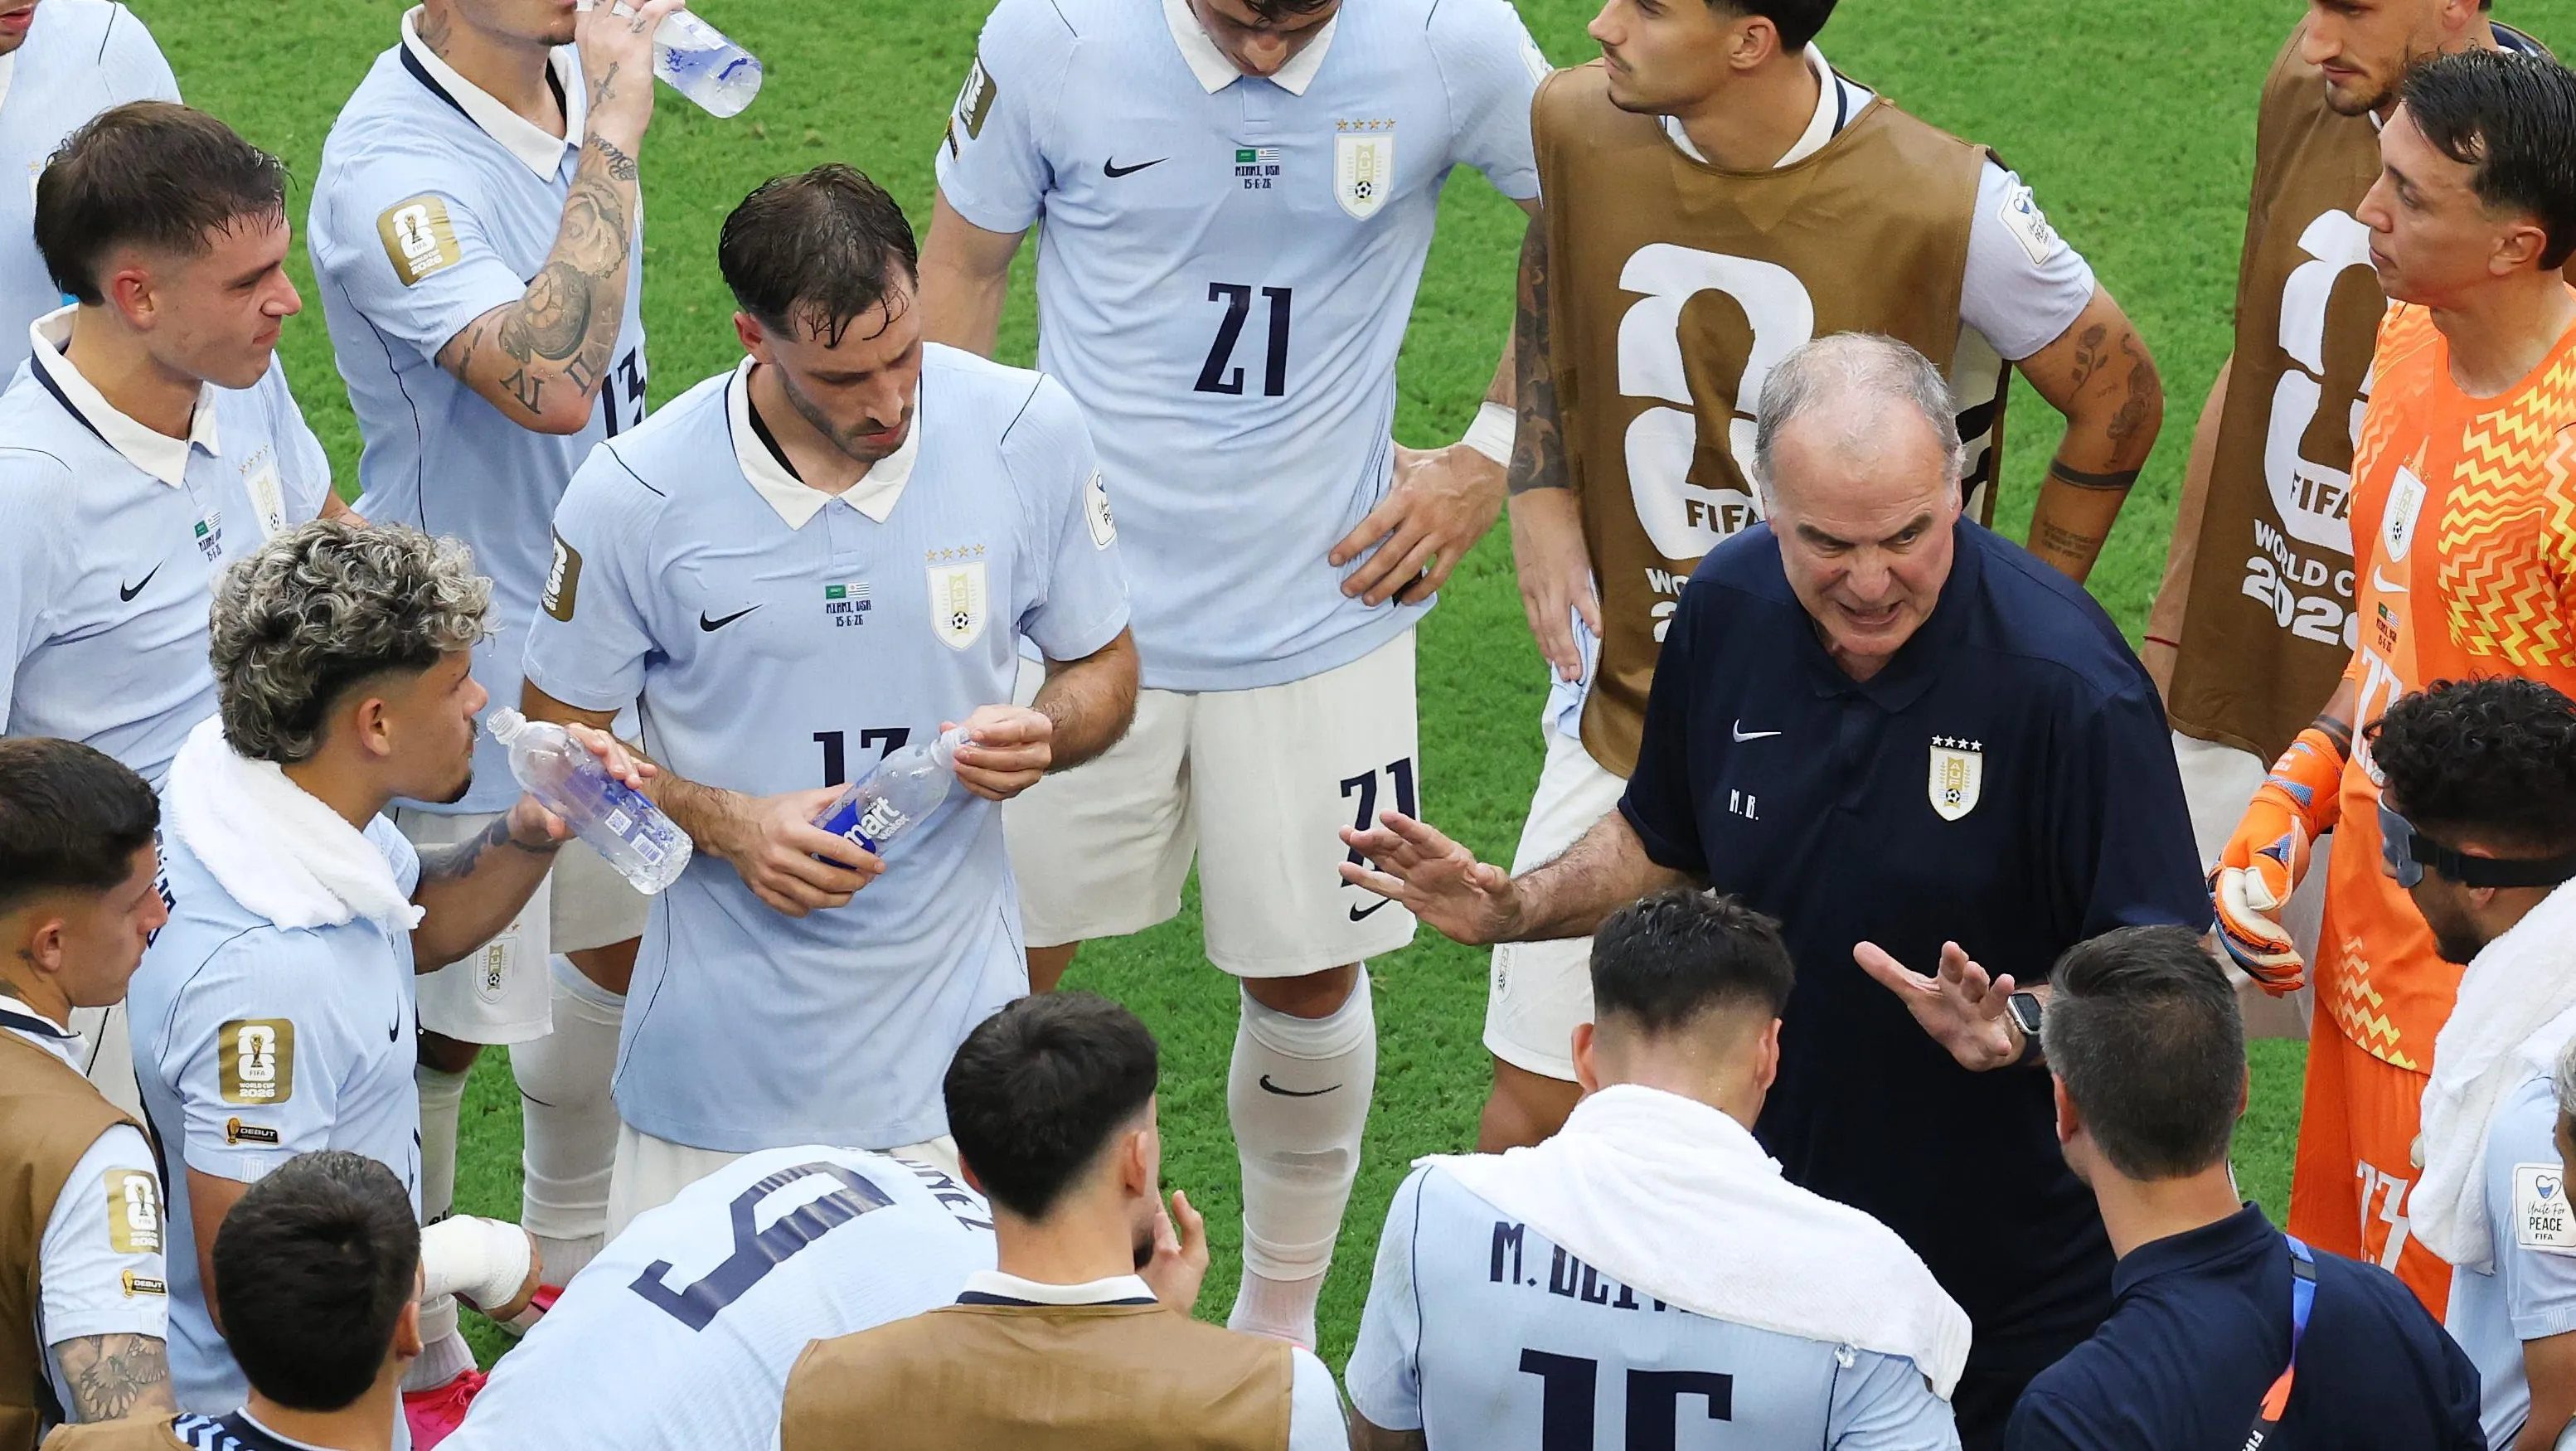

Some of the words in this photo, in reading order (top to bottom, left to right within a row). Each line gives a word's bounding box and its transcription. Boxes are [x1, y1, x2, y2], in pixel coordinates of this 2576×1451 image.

[1193, 282, 1293, 396] 21
[1729, 789, 1743, 815] M.
[1745, 794, 1759, 821] B.
[239, 1089, 276, 1099] 2026
[240, 1128, 277, 1138] DEBUT
[2527, 1200, 2551, 1216] Unite
[2551, 1202, 2566, 1216] For
[2529, 1216, 2564, 1233] PEACE
[2535, 1233, 2554, 1241] FIFA
[1490, 1221, 1537, 1286] M.
[133, 1279, 163, 1288] DEBUT
